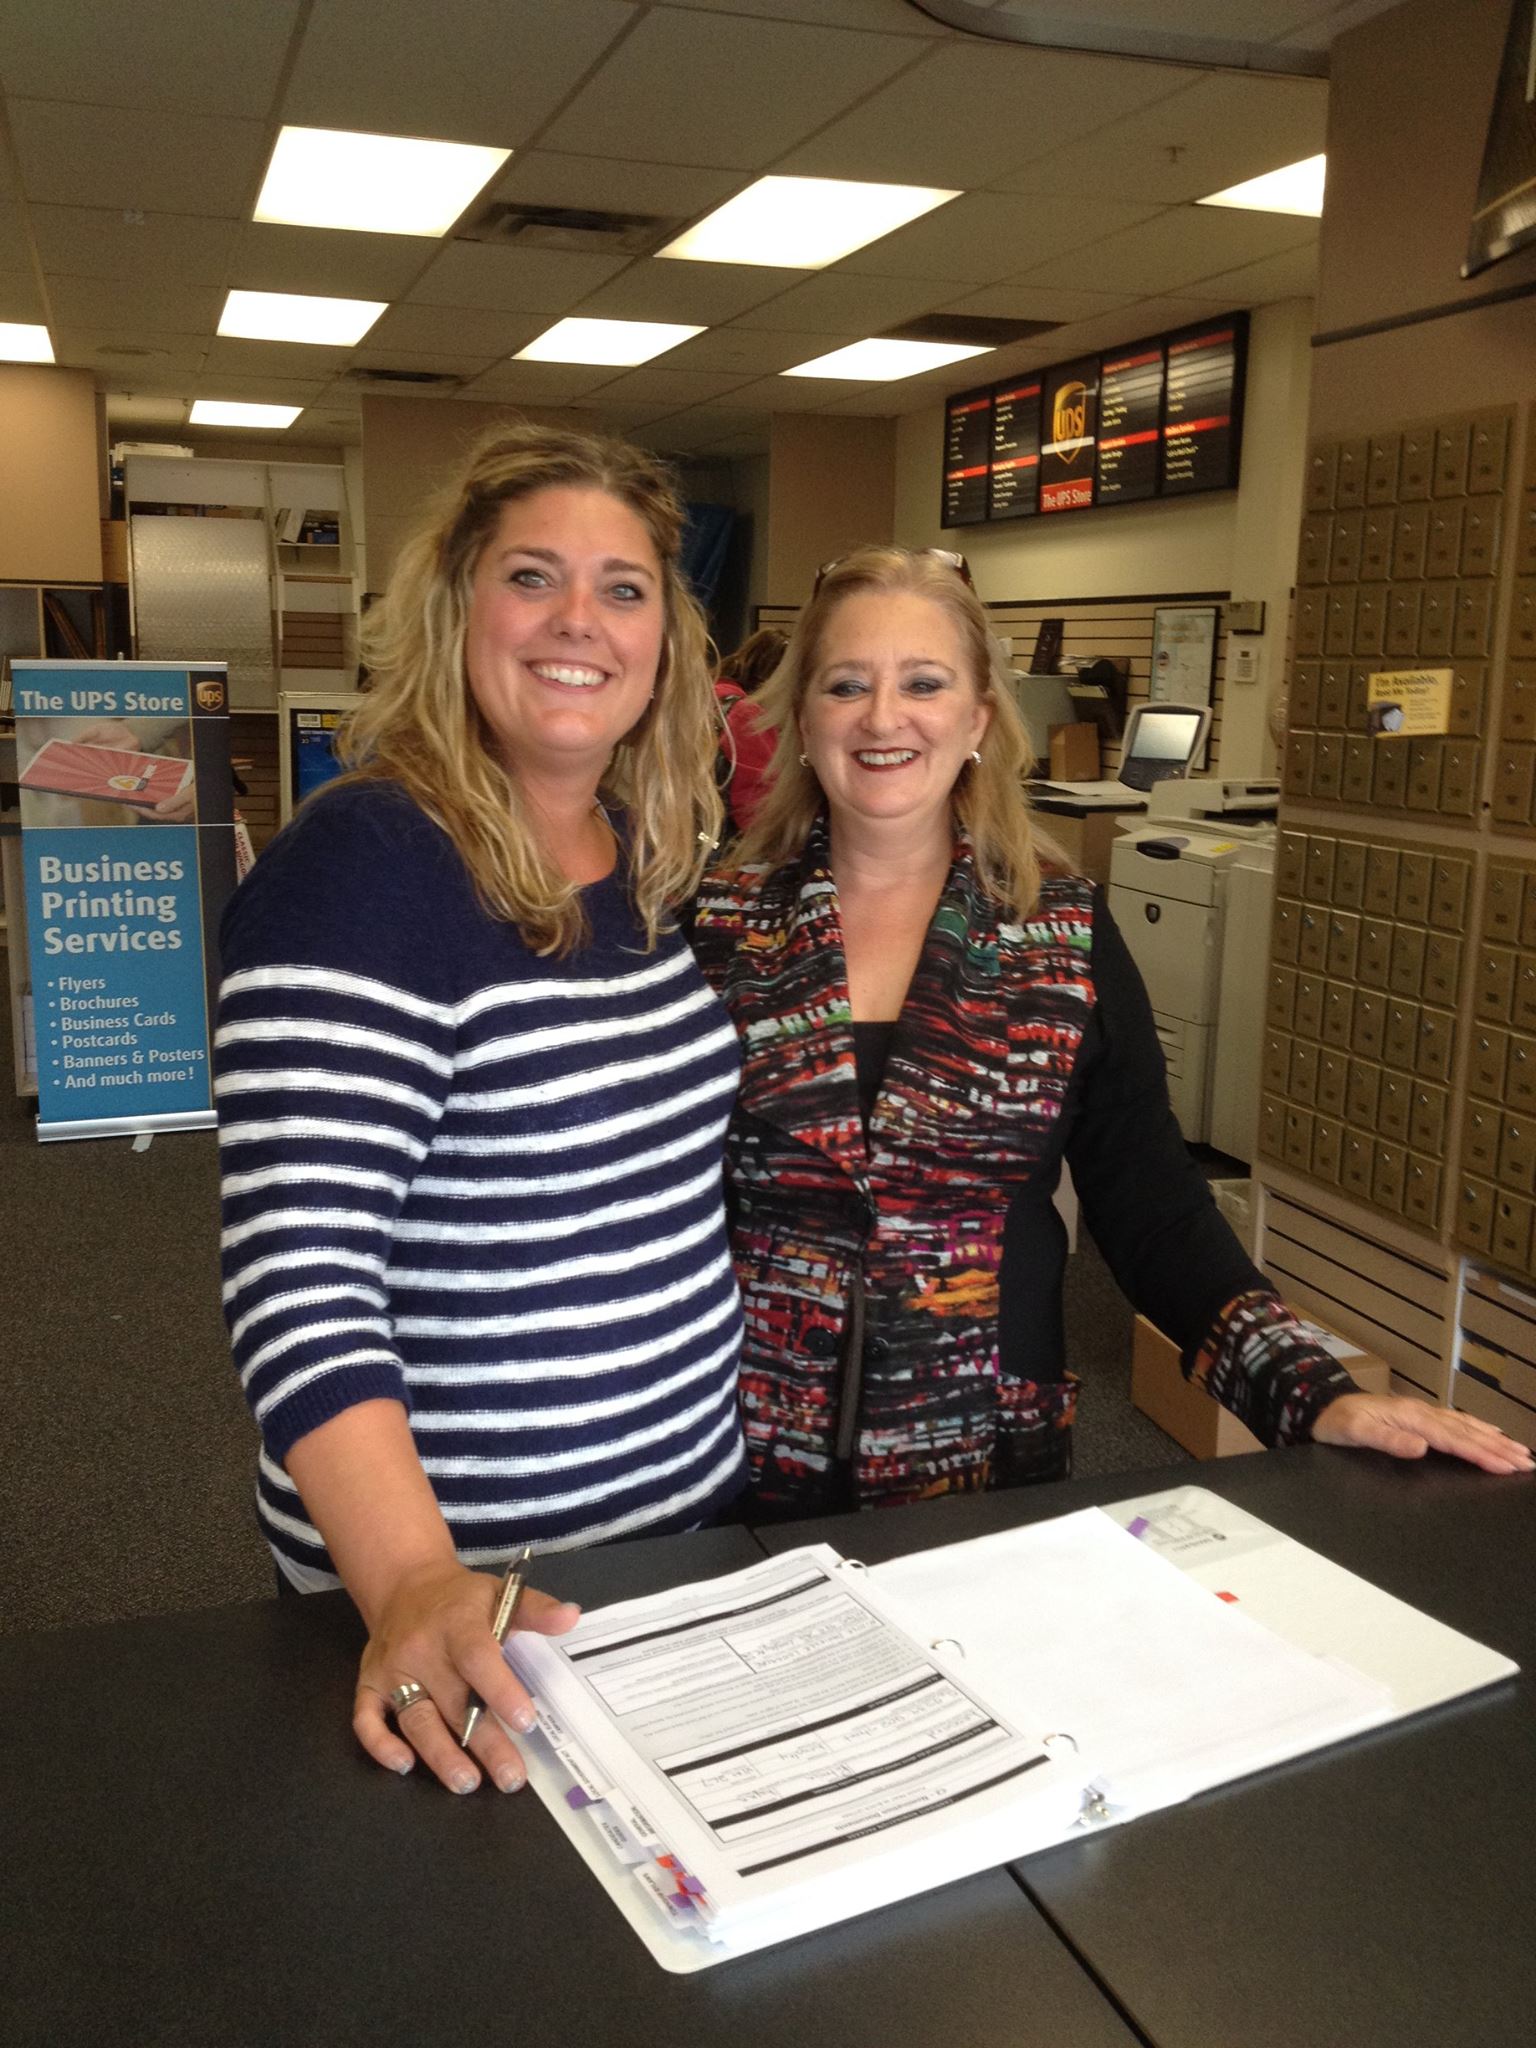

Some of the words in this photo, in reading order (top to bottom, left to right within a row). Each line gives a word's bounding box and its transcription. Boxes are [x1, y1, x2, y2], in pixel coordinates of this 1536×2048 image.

[1043, 493, 1056, 509] The
[1056, 491, 1071, 507] UPS
[1072, 489, 1092, 505] Store
[20, 690, 63, 711] The
[71, 691, 117, 711] UPS
[124, 691, 183, 712] Store
[200, 690, 222, 706] ups
[40, 855, 184, 884] Business
[41, 889, 176, 922] Printing
[44, 924, 182, 954] Services
[59, 977, 106, 993] Flyers
[60, 996, 139, 1011] Brochures
[61, 1016, 129, 1031] Business
[134, 1012, 176, 1027] Cards
[62, 1032, 138, 1048] Postcards
[64, 1053, 128, 1069] Banners
[132, 1051, 144, 1064] &
[150, 1049, 205, 1064] Posters
[65, 1073, 96, 1089] And
[101, 1070, 143, 1086] much
